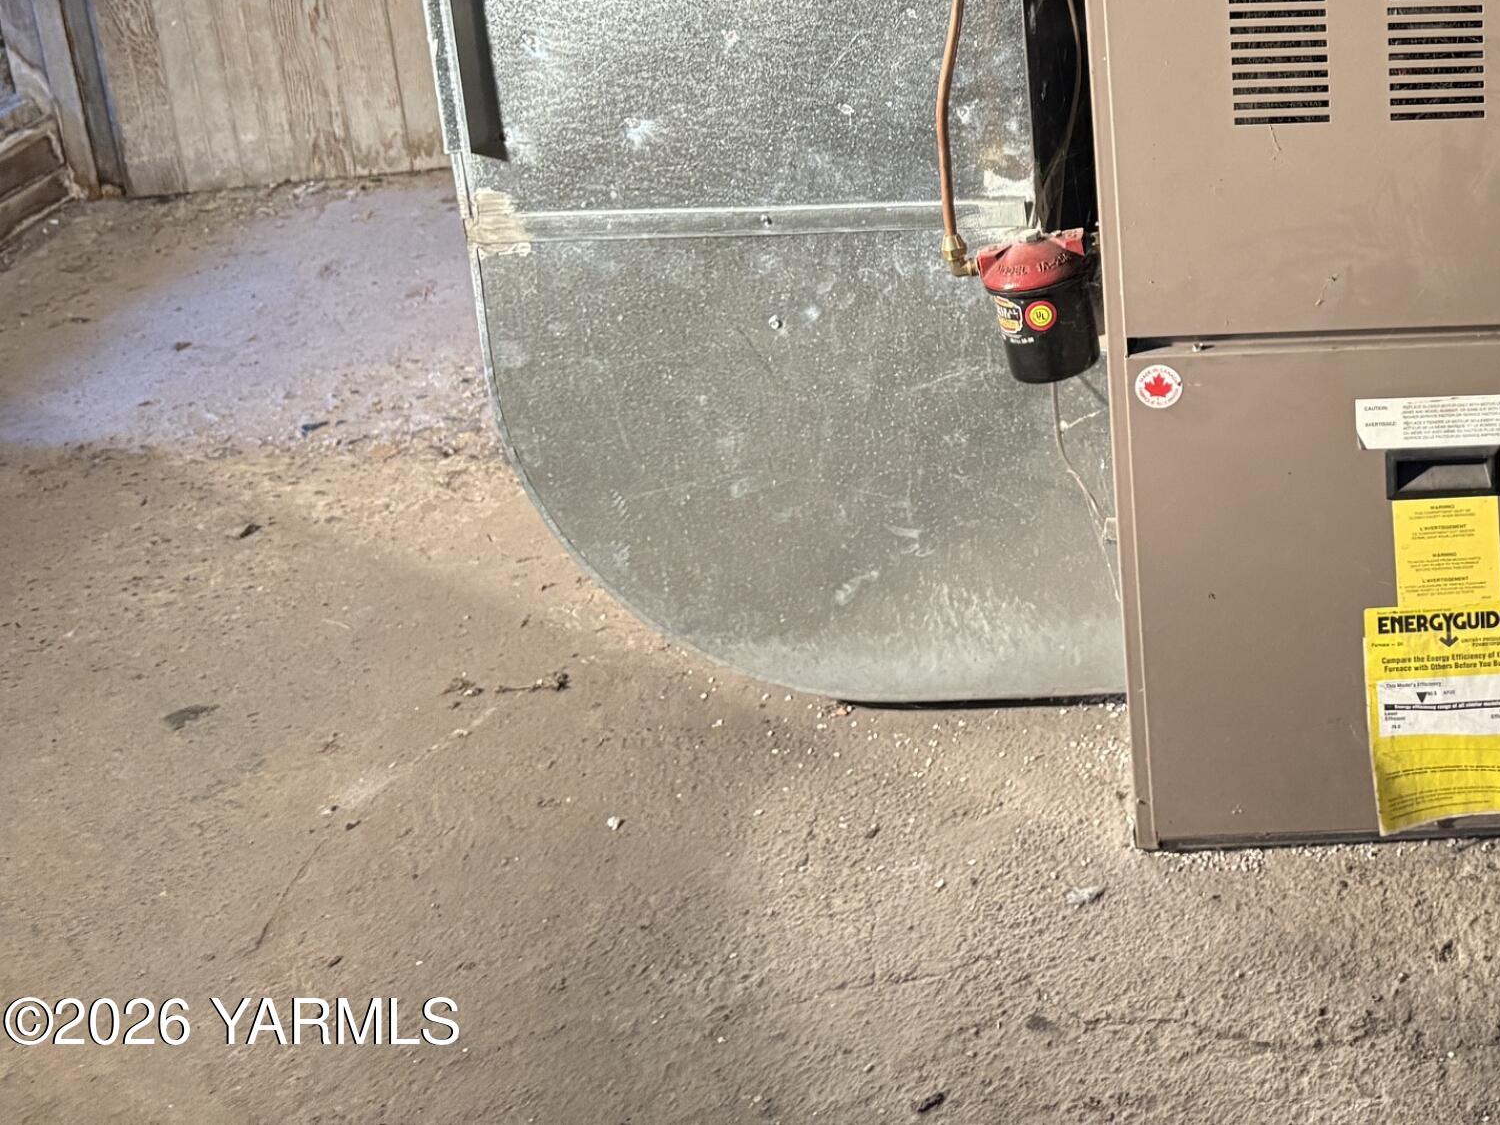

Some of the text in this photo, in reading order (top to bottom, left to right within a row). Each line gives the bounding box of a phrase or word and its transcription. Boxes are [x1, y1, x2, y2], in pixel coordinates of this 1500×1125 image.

[1382, 656, 1411, 665] Compare
[1426, 653, 1450, 663] Energy
[1451, 652, 1486, 661] Efficiency
[1384, 665, 1412, 673] Furnace
[1414, 663, 1429, 671] with
[1430, 662, 1452, 671] Others
[1454, 661, 1477, 669] Before
[1479, 660, 1491, 668] You
